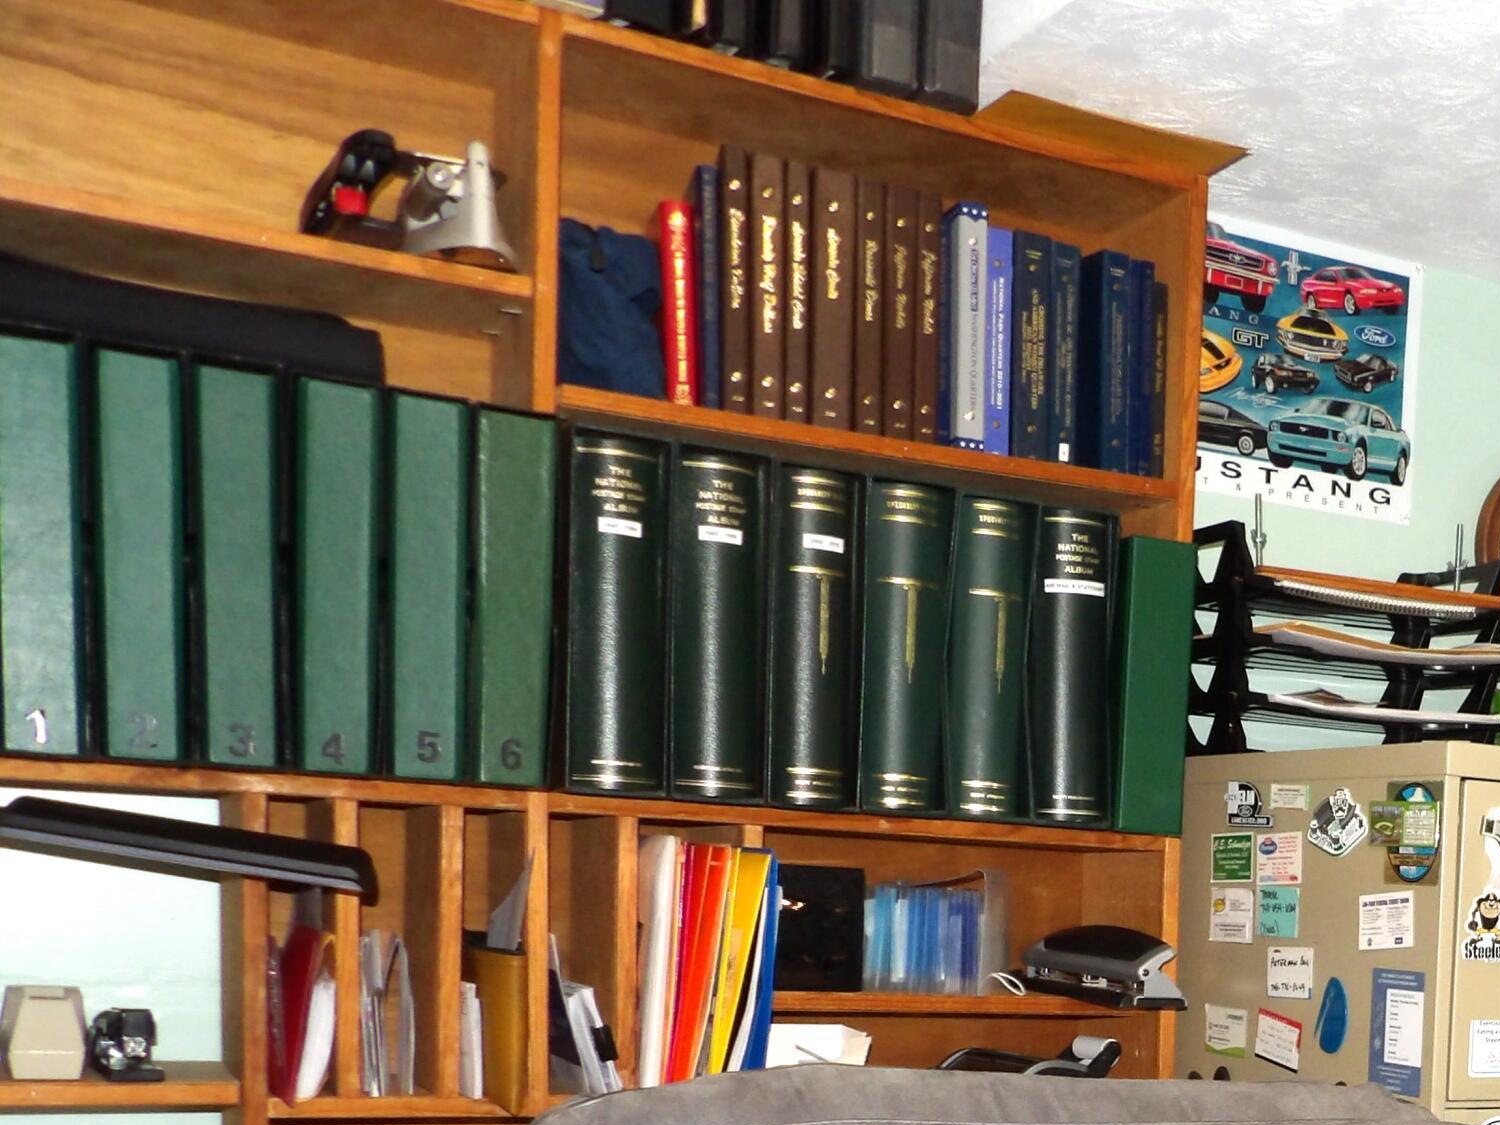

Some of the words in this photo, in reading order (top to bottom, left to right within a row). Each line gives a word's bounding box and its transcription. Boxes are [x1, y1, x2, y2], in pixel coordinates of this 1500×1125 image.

[894, 244, 907, 289] Jefferson
[921, 250, 938, 296] Jefferson
[970, 314, 978, 368] WASHINGTON
[1232, 326, 1269, 348] GT
[1361, 325, 1388, 345] Ford
[608, 464, 633, 478] THE
[712, 479, 734, 490] THE
[1194, 456, 1392, 506] STANG
[1267, 488, 1380, 514] PRESENT
[1057, 543, 1098, 554] NATIONAL
[1072, 533, 1089, 543] THE
[1064, 565, 1093, 575] ALBUM
[25, 708, 47, 745] 1
[127, 713, 158, 750] 2
[228, 722, 256, 758] 3
[321, 732, 346, 766] 4
[415, 730, 442, 764] 5
[500, 738, 523, 771] 6
